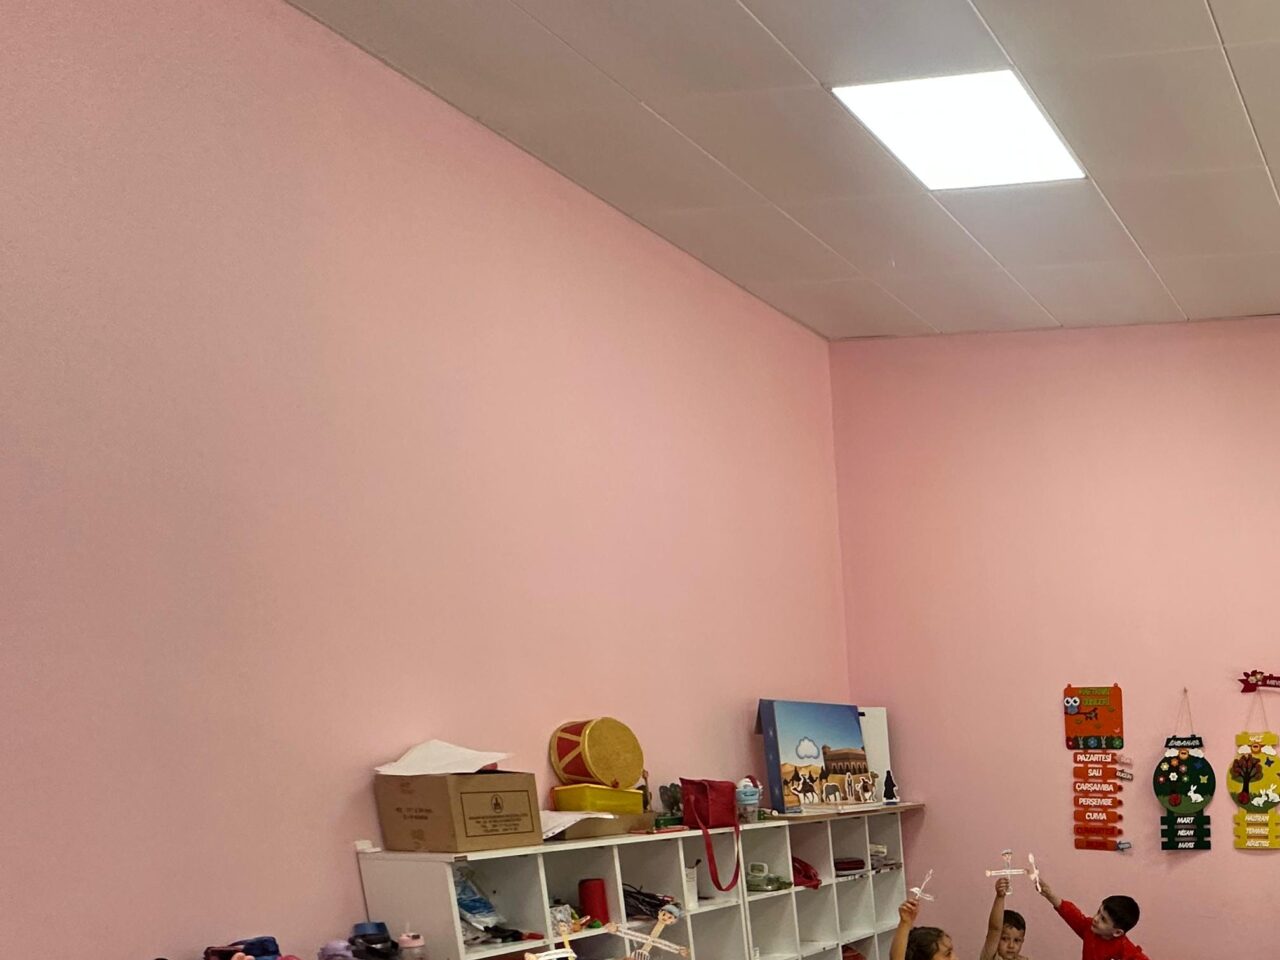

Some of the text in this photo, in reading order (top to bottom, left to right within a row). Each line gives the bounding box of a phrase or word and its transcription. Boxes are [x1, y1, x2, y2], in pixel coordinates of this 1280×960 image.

[1076, 753, 1112, 762] PAZARTESİ
[1087, 768, 1103, 777] SALI
[1075, 782, 1114, 793] ÇARŞAMBA
[1085, 812, 1107, 820] CUMA
[1176, 816, 1195, 824] MART
